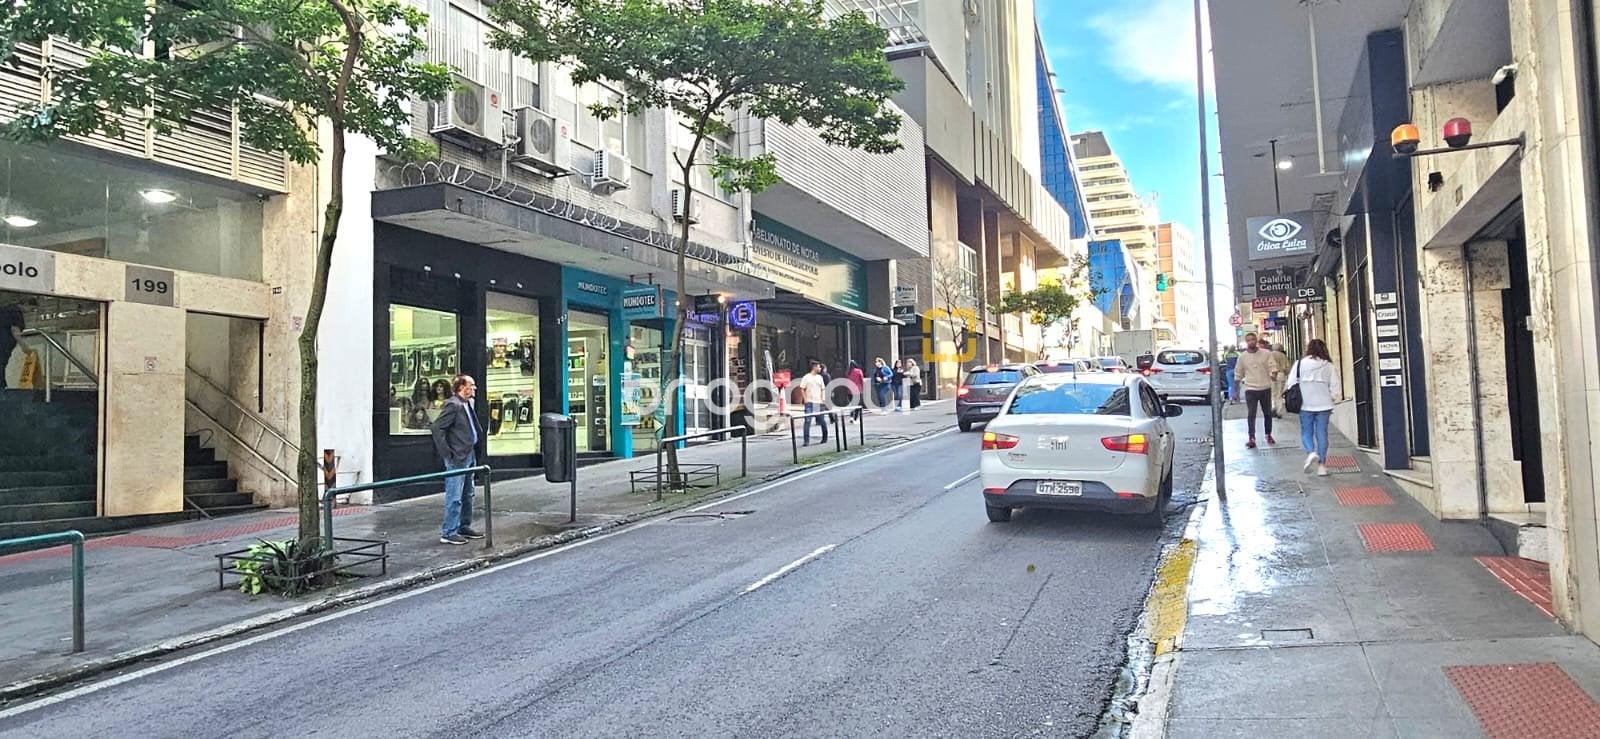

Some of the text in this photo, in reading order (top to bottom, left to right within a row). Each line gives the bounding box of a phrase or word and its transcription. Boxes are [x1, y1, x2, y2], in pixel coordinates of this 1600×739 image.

[1257, 240, 1281, 251] Ótica
[1260, 274, 1292, 284] Galeria
[131, 278, 168, 294] 199
[578, 281, 608, 295] MUNDOTEC
[1260, 281, 1293, 291] Central
[1298, 288, 1316, 297] DB
[623, 295, 655, 308] MUNDOTEC
